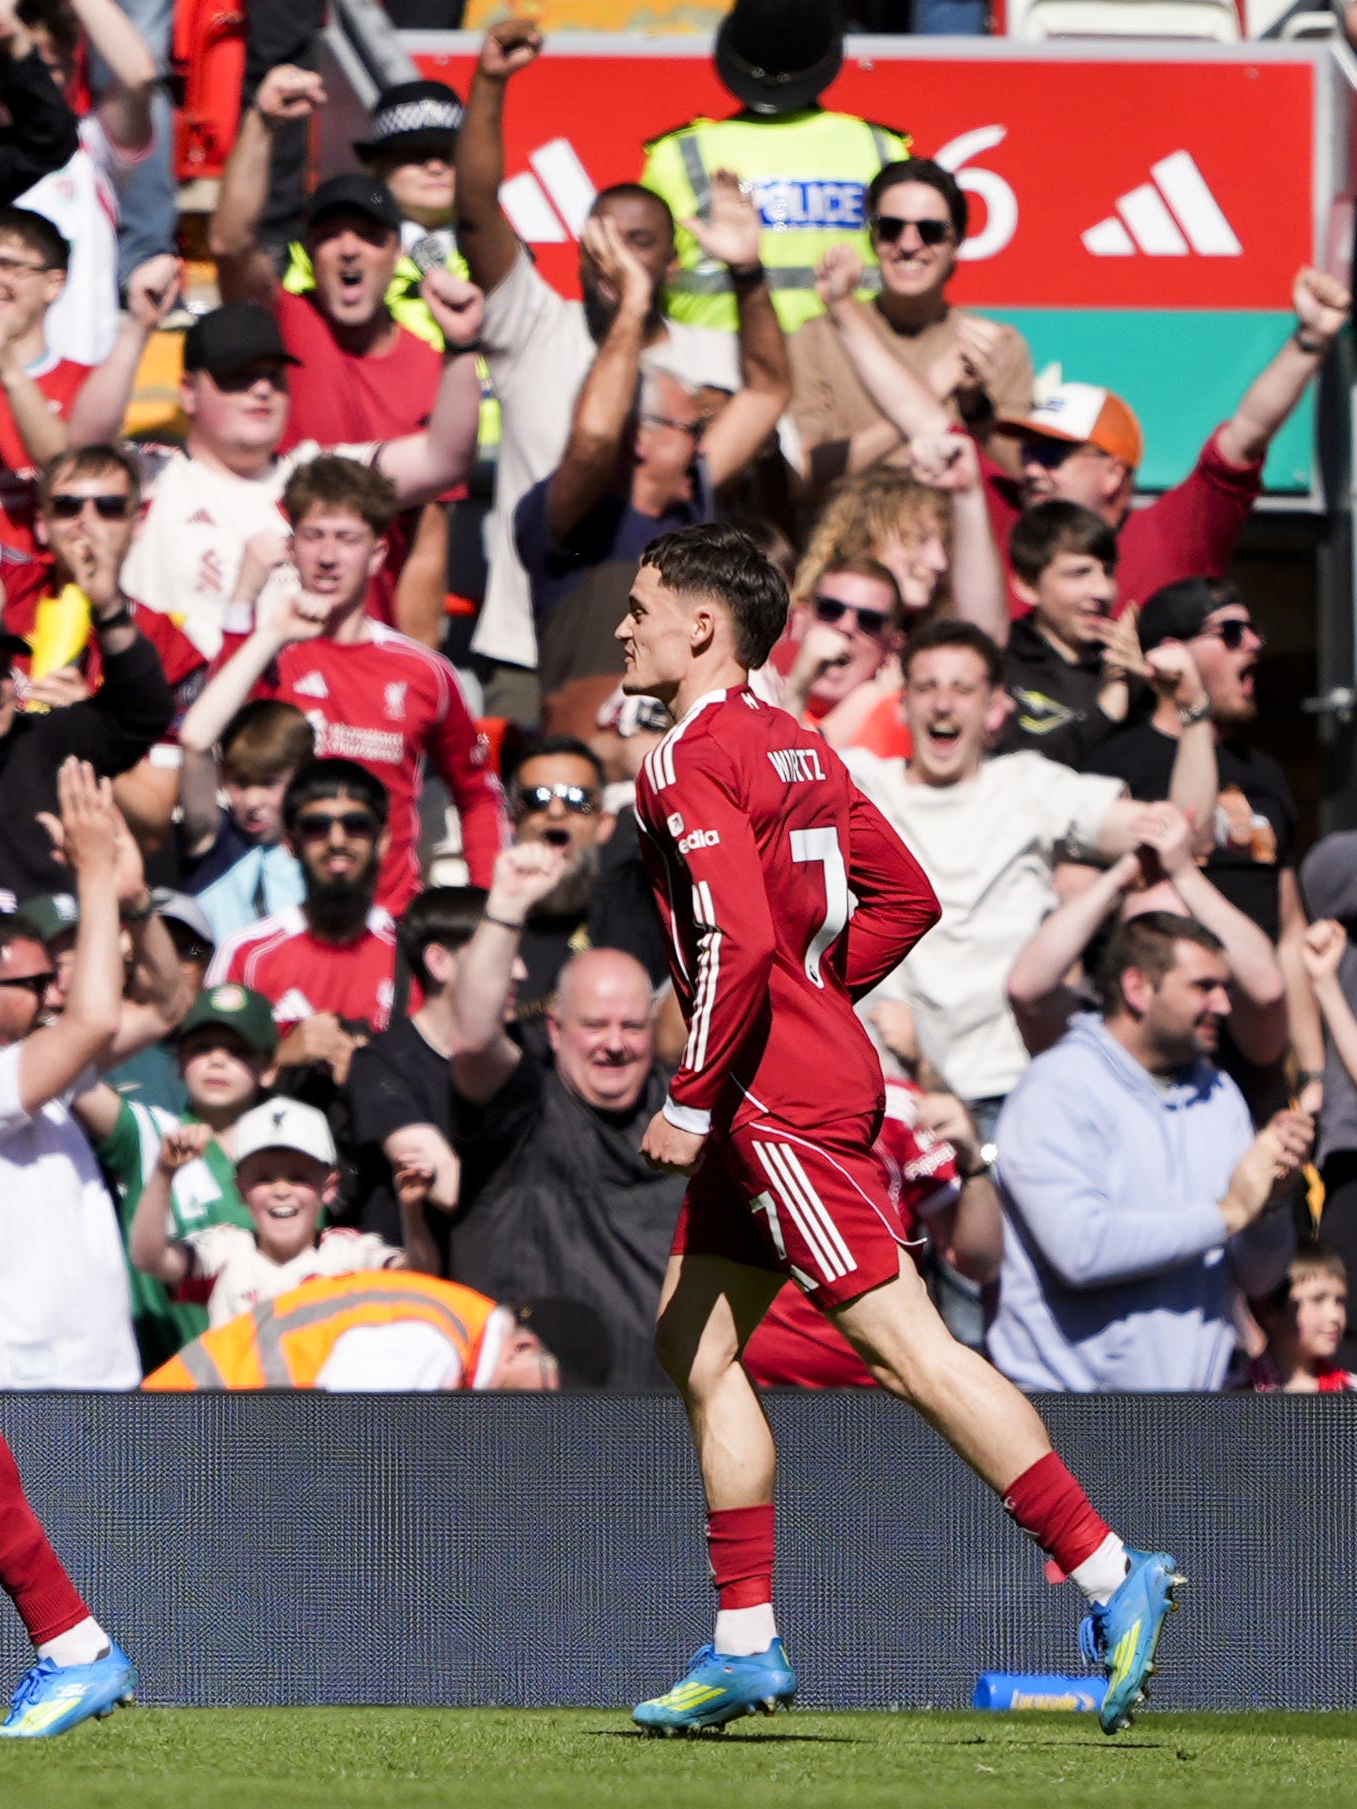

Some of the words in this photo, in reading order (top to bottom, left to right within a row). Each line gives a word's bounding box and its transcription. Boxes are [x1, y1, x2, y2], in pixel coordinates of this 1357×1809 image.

[752, 182, 863, 222] POLICE
[767, 749, 827, 783] WIRTZ
[678, 828, 721, 854] edia
[789, 826, 848, 989] 7
[749, 1191, 787, 1260] 7
